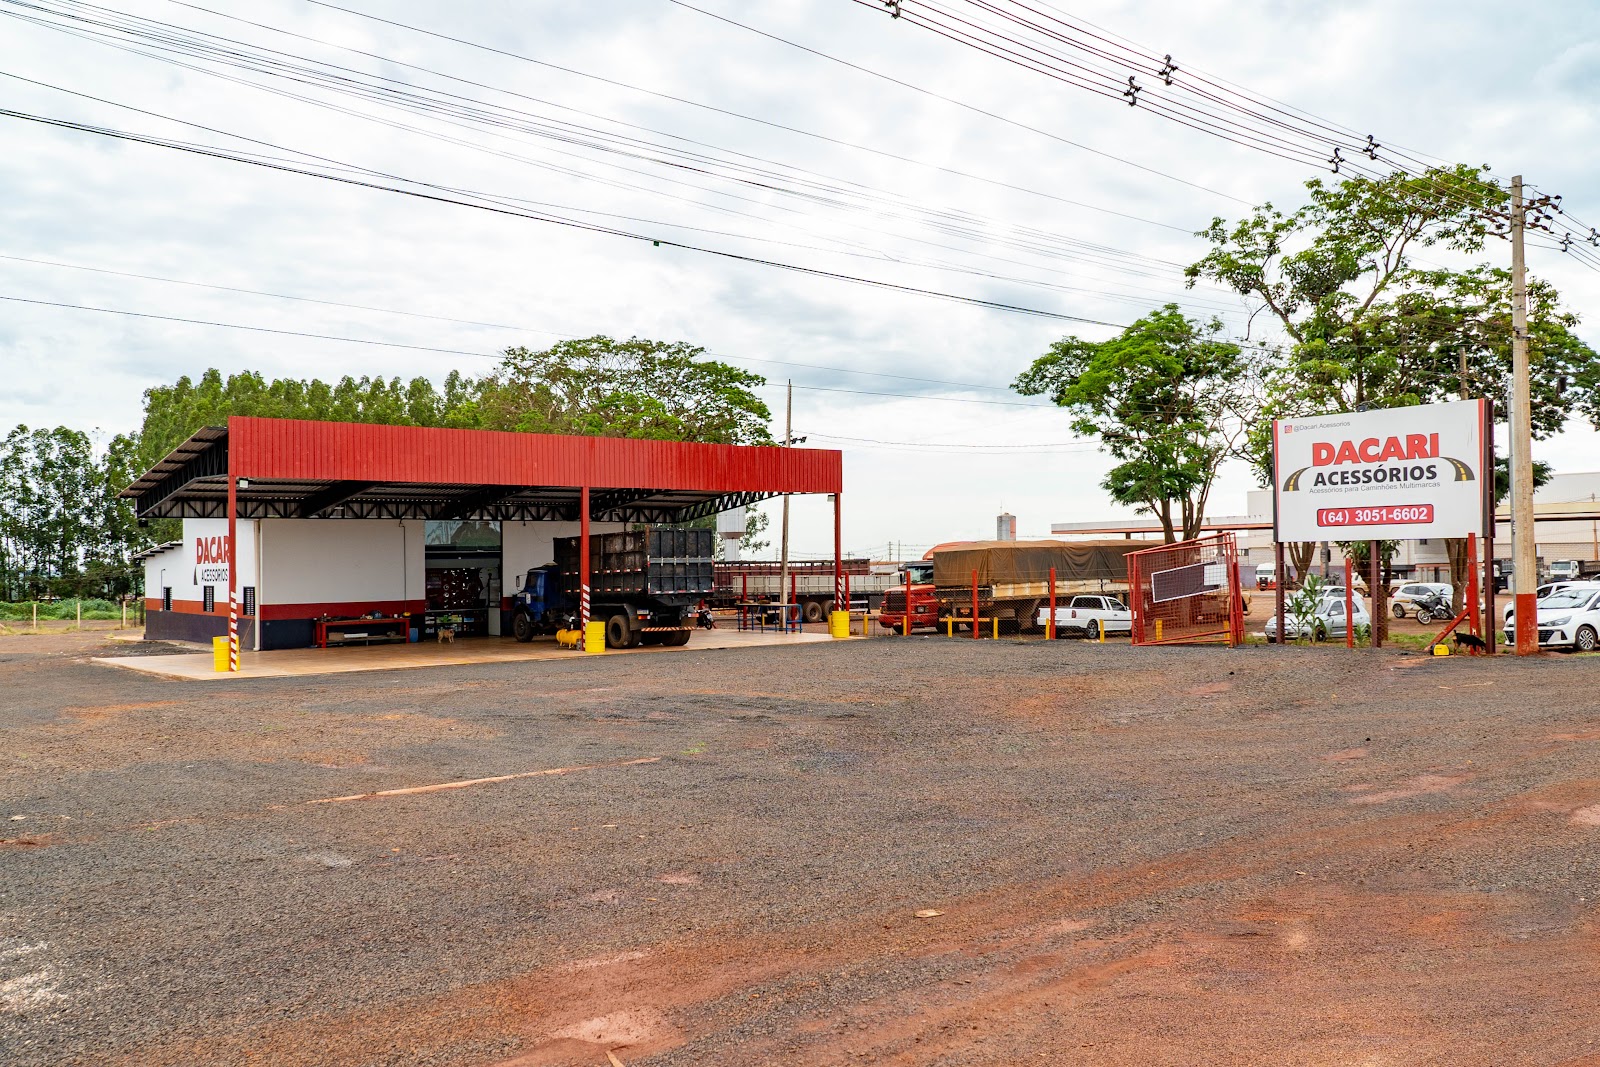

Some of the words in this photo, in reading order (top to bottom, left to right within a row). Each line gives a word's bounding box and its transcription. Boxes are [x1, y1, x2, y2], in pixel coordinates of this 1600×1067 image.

[1312, 433, 1439, 467] DACARI
[1313, 464, 1437, 487] ACESSÓRIOS
[1360, 483, 1398, 492] Caminhões
[1399, 481, 1441, 489] Multimarcas
[1322, 510, 1349, 524] (64)
[1355, 507, 1428, 522] 3051-6602
[196, 535, 230, 564] DACAR
[201, 566, 228, 582] ACESSÓRIOS
